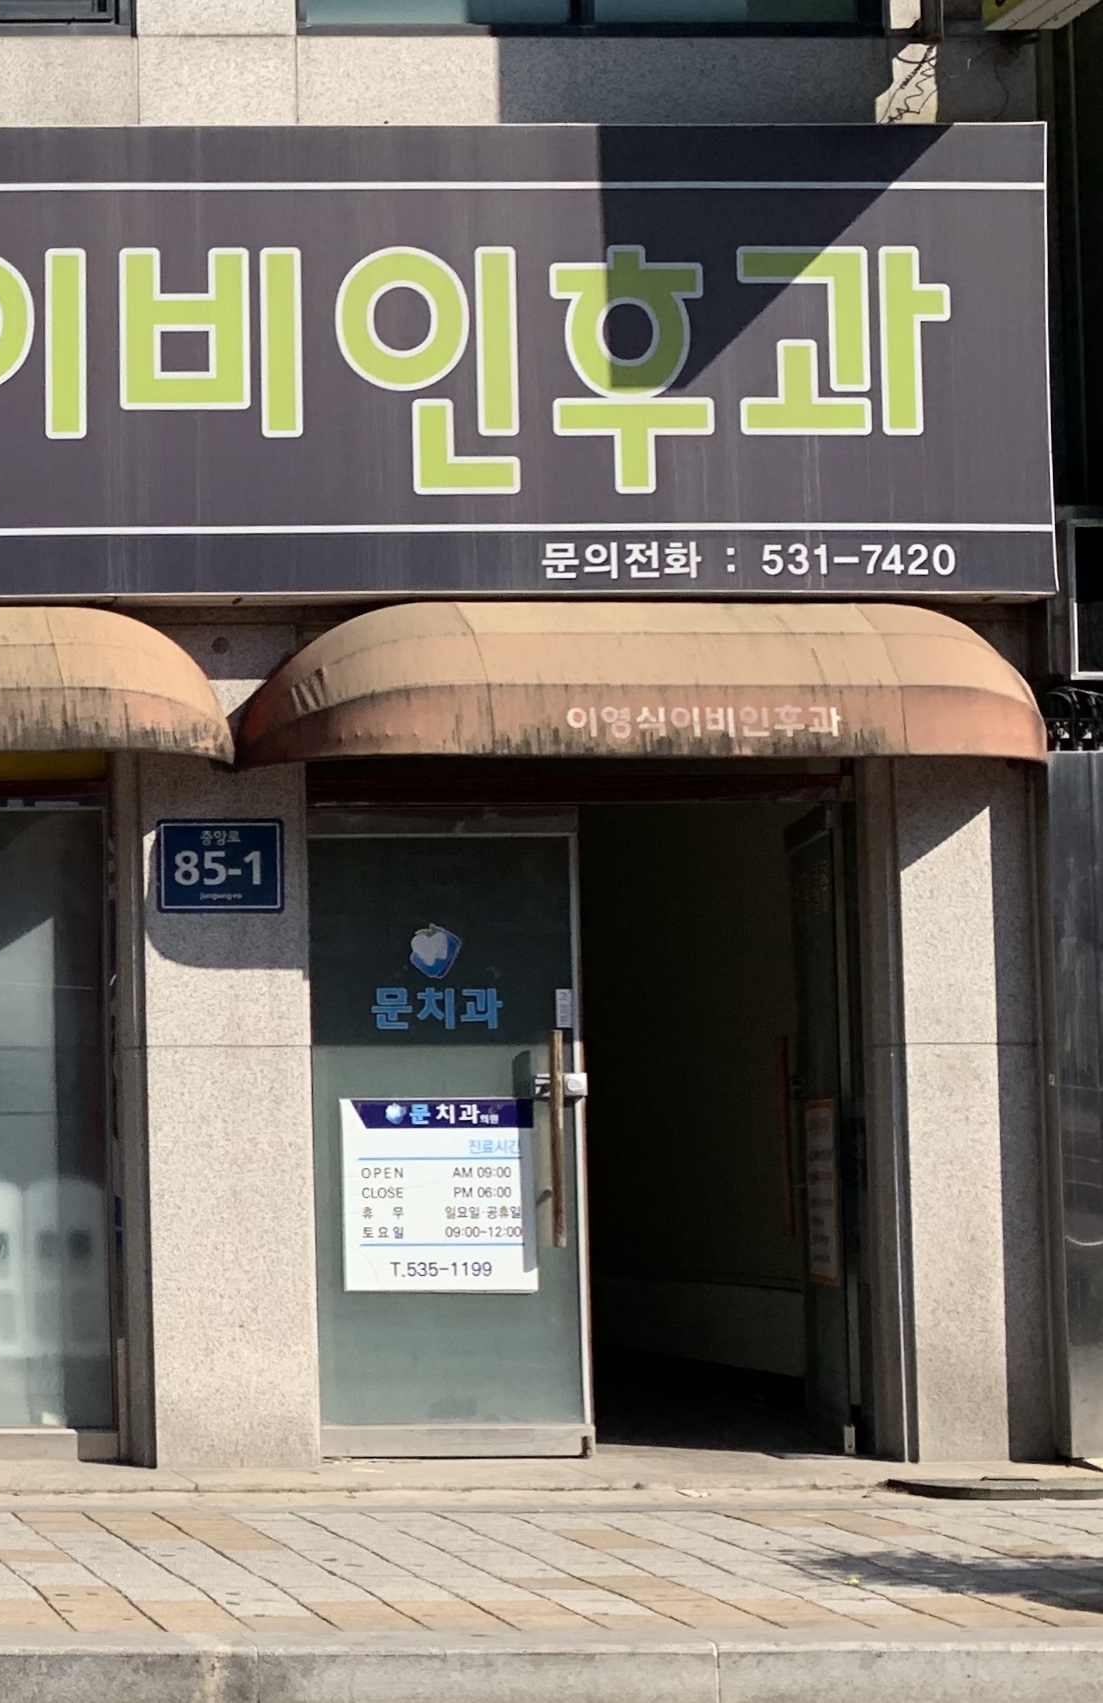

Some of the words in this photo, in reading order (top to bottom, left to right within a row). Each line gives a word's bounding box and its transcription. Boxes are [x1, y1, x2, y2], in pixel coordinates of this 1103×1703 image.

[541, 541, 702, 579] 문의전화
[761, 543, 956, 576] 531-7420
[566, 705, 842, 739] 이영식이비인후과
[199, 830, 241, 846] 중앙로
[174, 850, 262, 886] 85-1
[371, 987, 503, 1030] 문치과
[361, 1167, 404, 1179] OPEN
[452, 1167, 473, 1179] AM
[477, 1166, 512, 1180] 09:00
[361, 1187, 404, 1199] CLOSE
[453, 1187, 473, 1199] PM
[477, 1186, 512, 1199] 06:00
[390, 1262, 493, 1277] T.535-1199
